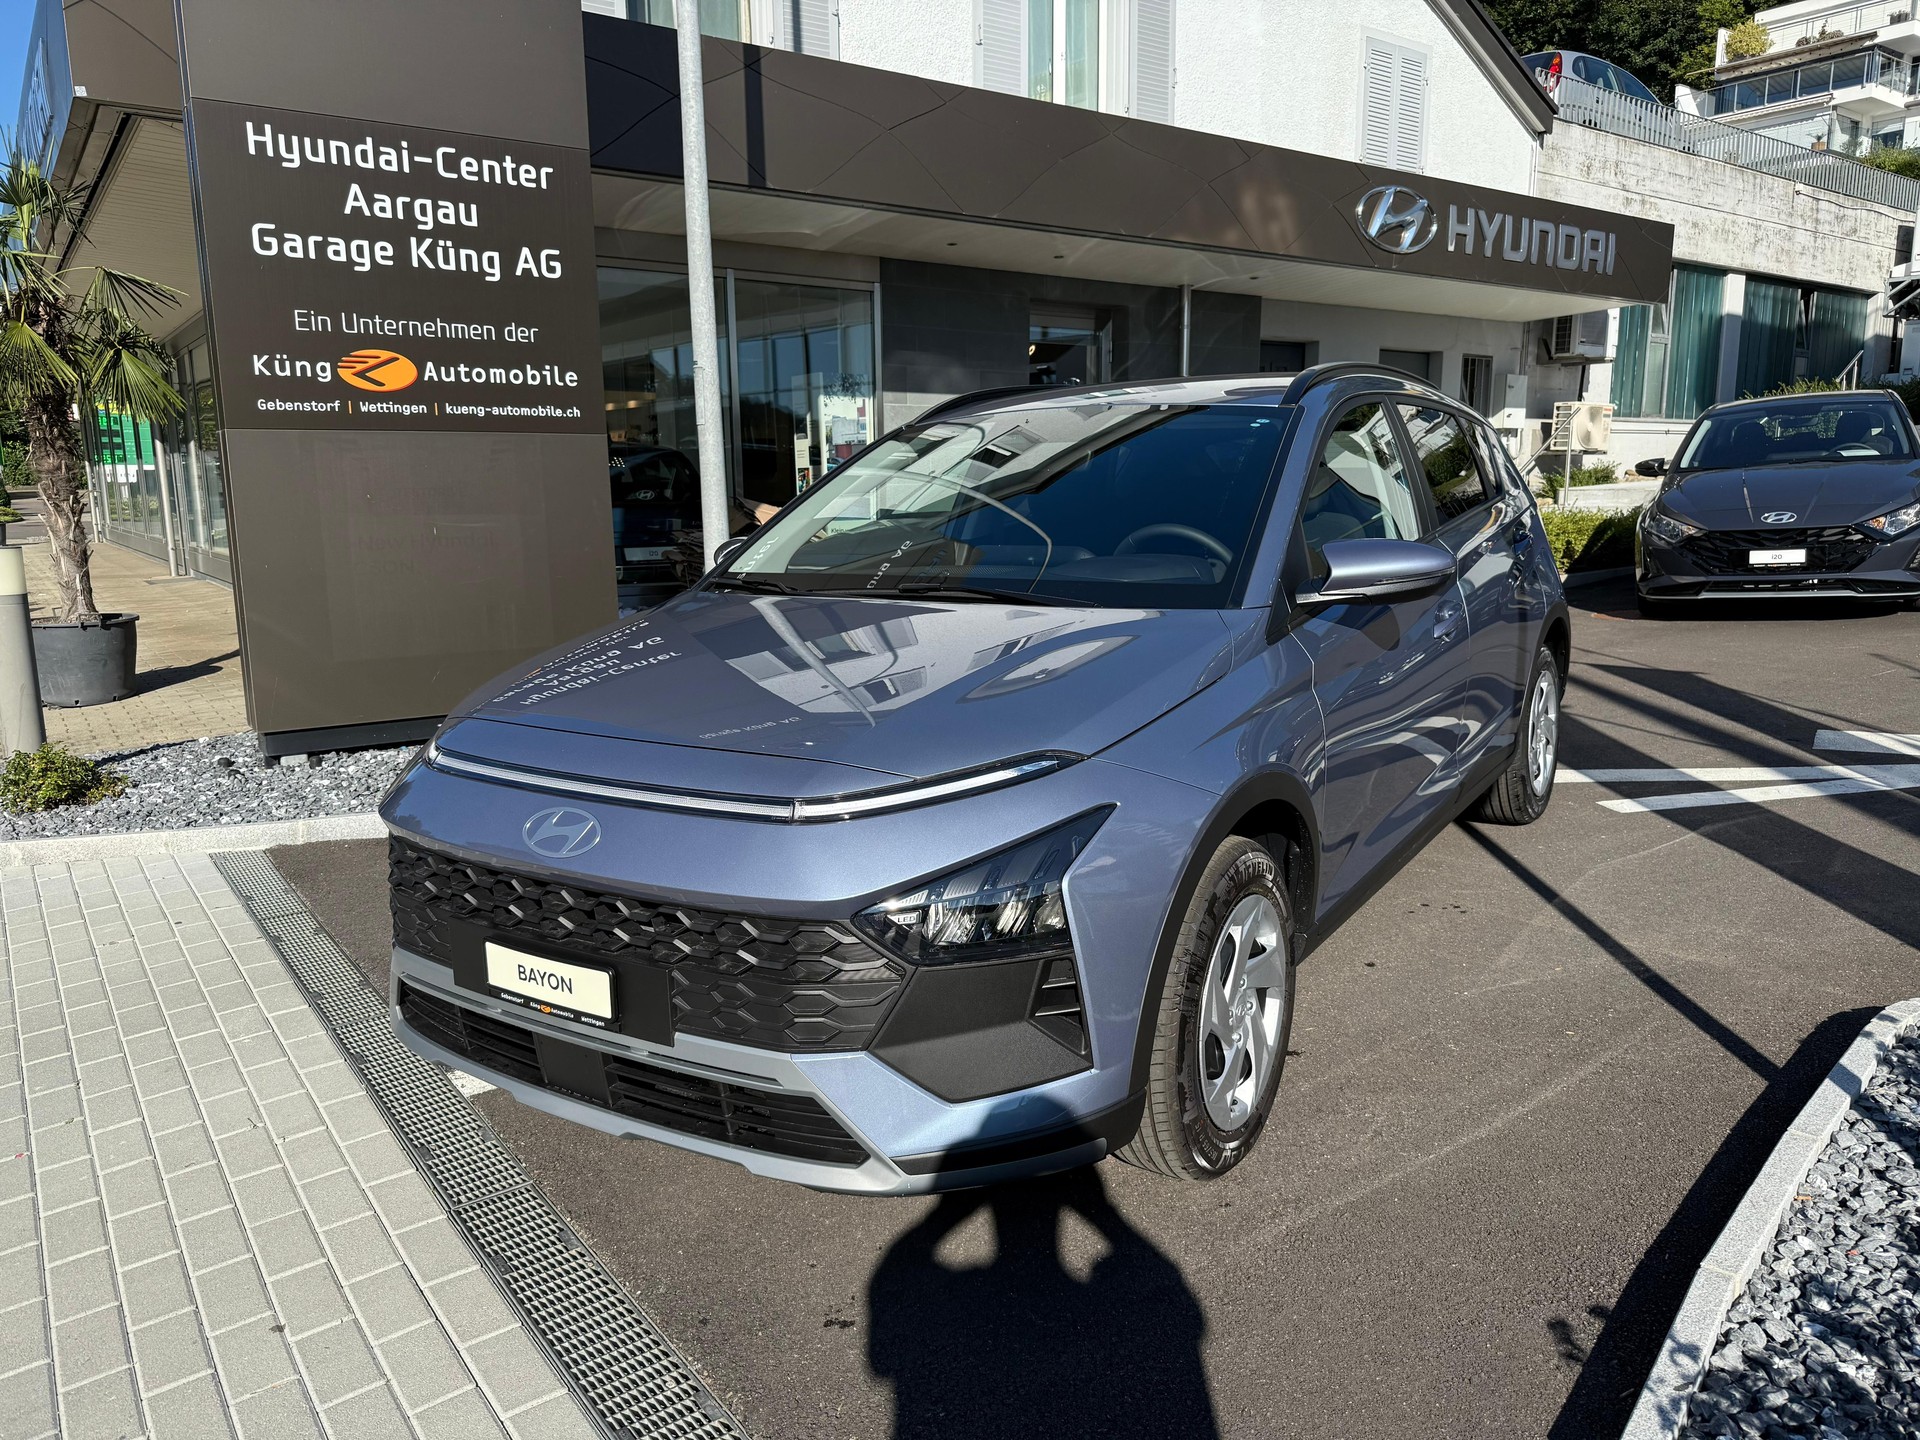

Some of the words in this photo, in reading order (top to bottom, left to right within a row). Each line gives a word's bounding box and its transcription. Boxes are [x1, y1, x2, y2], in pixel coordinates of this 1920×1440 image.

[245, 121, 554, 190] Hyundai-Center
[343, 183, 479, 231] Aargau
[251, 222, 394, 273] Garage
[409, 236, 501, 282] Küng
[515, 246, 562, 280] AG
[1447, 203, 1616, 276] HYUNDAI
[293, 309, 332, 333] Ein
[341, 312, 496, 341] Unternehmen
[504, 322, 539, 344] der
[252, 353, 333, 384] Küng
[423, 360, 579, 388] Automobile
[257, 398, 341, 413] Gebenstorf
[359, 400, 428, 416] Wettingen
[445, 403, 581, 419] kueng-automobile.ch
[517, 963, 573, 995] BAYON
